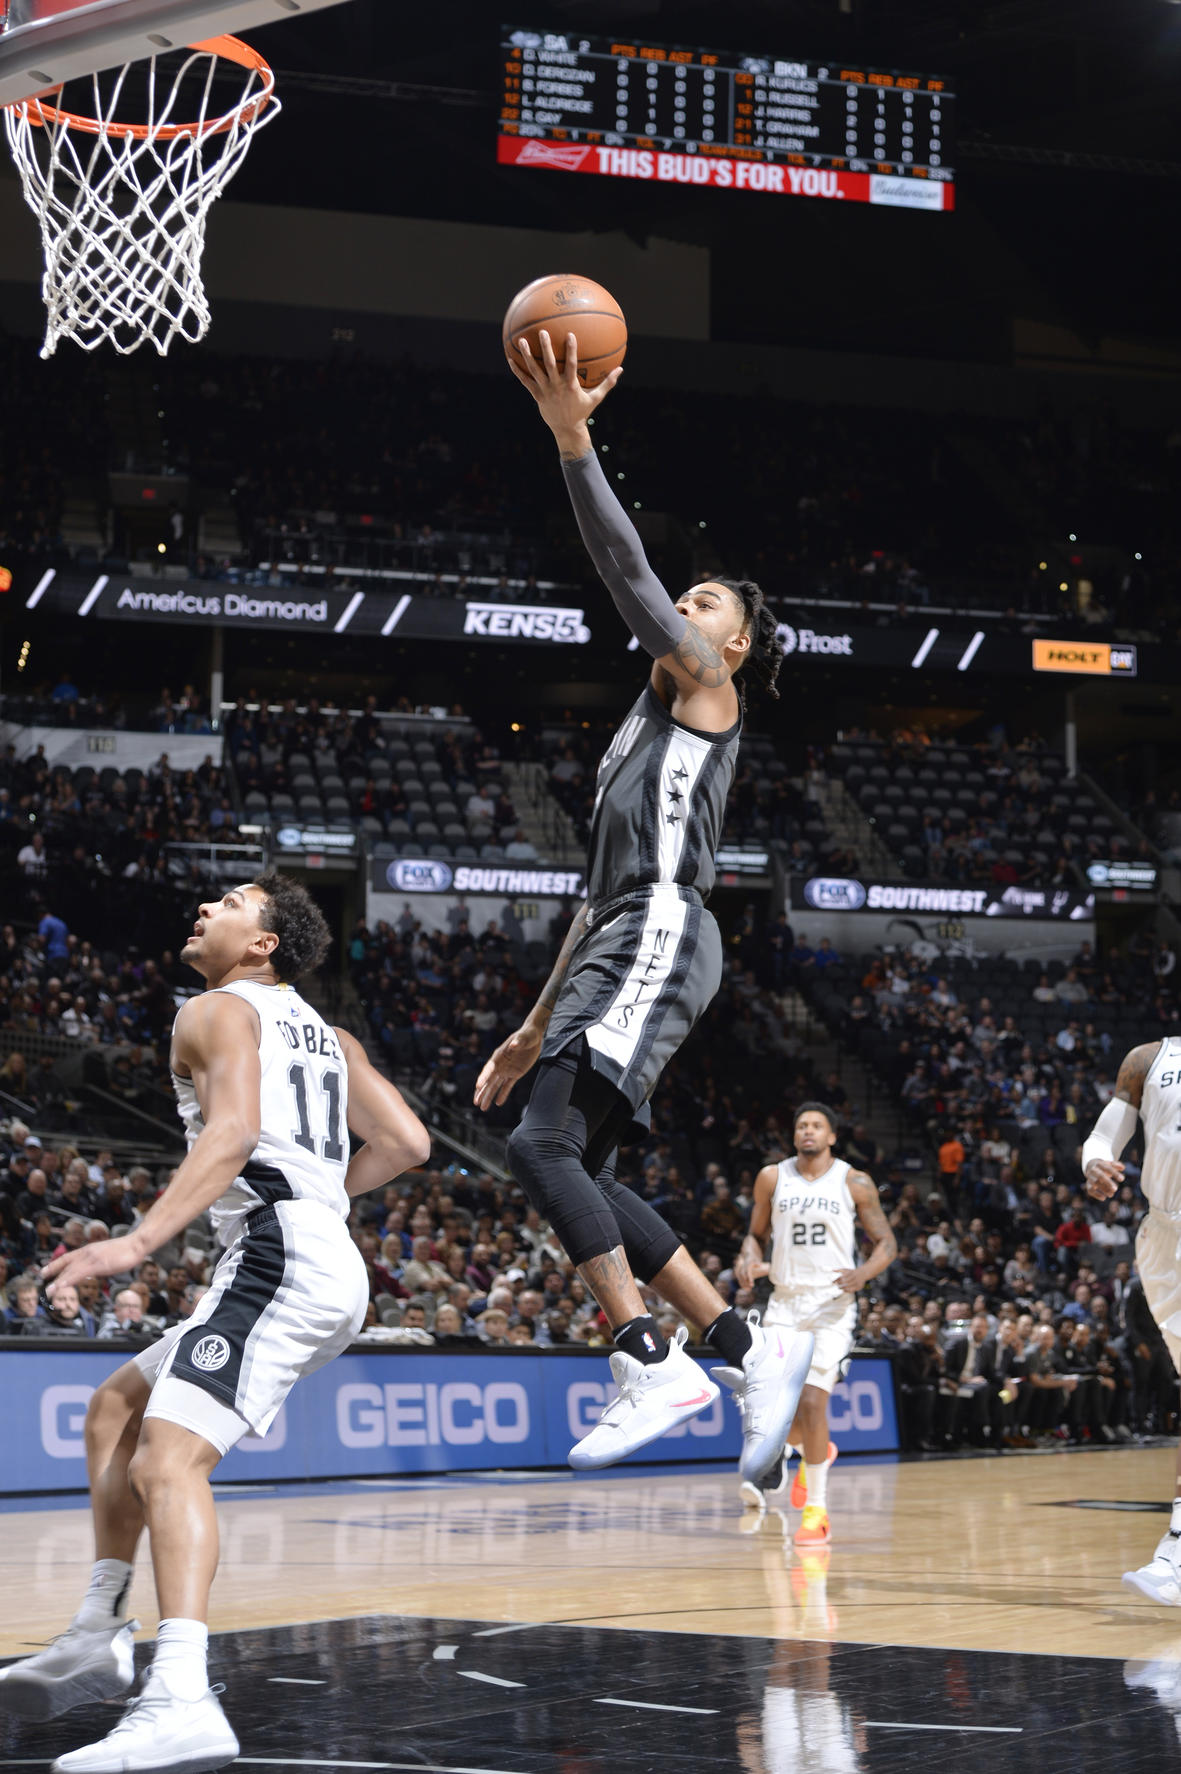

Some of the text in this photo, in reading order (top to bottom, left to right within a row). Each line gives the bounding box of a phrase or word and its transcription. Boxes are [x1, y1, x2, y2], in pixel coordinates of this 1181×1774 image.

[544, 34, 568, 51] SA
[597, 147, 654, 178] THIS
[657, 154, 733, 187] BUD'S
[735, 161, 784, 192] FOR
[787, 167, 845, 199] YOU.
[117, 588, 327, 621] Americus Diamond
[798, 629, 853, 655] Frost
[1047, 649, 1102, 663] HOLT
[402, 864, 582, 895] FOX SOUTHWEST
[819, 883, 988, 913] FOX SOUTHWEST
[618, 928, 670, 1030] NETS
[286, 1060, 345, 1164] 11
[778, 1196, 841, 1216] SPURS
[792, 1223, 827, 1246] 22
[336, 1382, 530, 1448] GEICO
